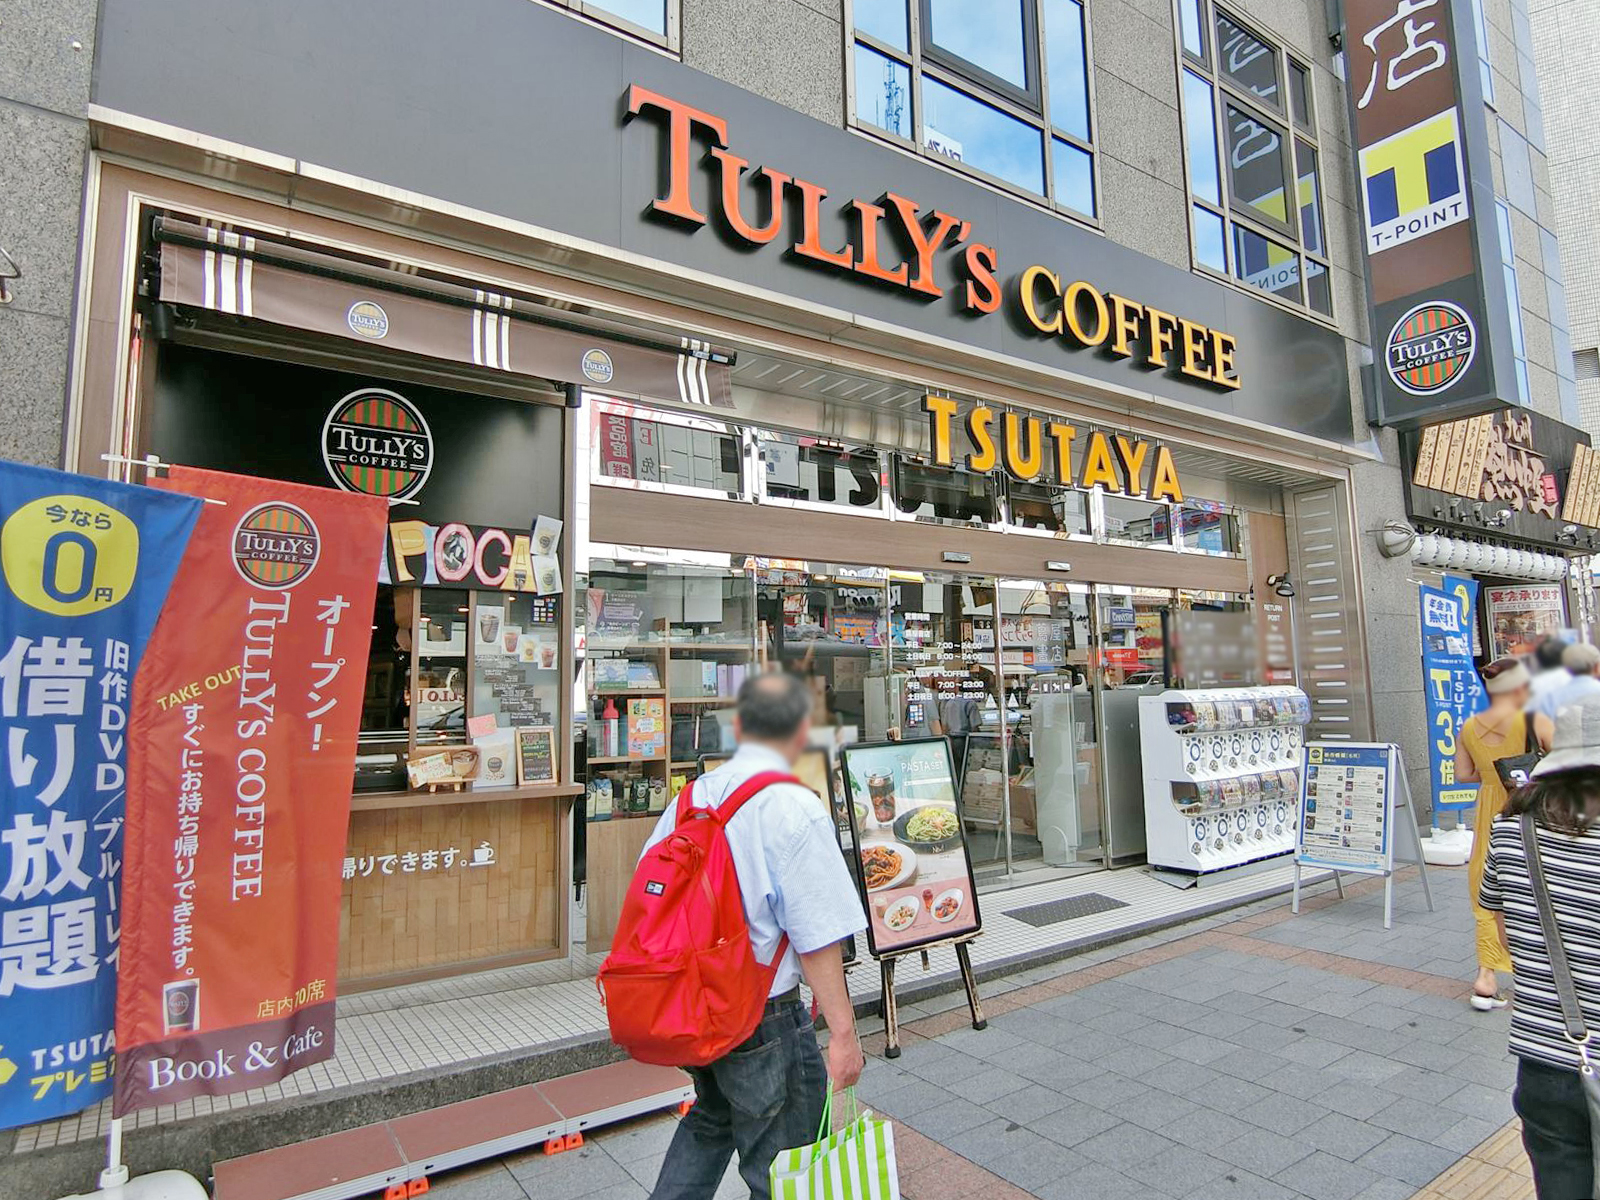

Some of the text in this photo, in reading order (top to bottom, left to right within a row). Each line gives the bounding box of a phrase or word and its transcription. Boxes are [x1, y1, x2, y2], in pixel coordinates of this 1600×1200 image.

[628, 83, 1242, 390] TULLY'S COFFEE
[1372, 202, 1463, 247] T-POINT
[1392, 331, 1467, 362] TULLY'S
[1406, 350, 1455, 369] COFFEE
[332, 427, 425, 460] TULLY'S
[348, 453, 408, 469] COFFEE
[925, 394, 1185, 503] TSUTAYA
[45, 504, 113, 530] 今なら
[240, 531, 313, 556] TULLY'S
[251, 551, 299, 563] COFFEE
[377, 521, 537, 592] PIOCA
[1263, 603, 1283, 612] RETURN
[936, 641, 953, 649] 7:00
[961, 641, 982, 650] 24:00
[157, 665, 242, 712] TAKE OUT
[305, 594, 351, 751] オープン!
[937, 681, 955, 689] 7:00
[1454, 670, 1465, 732] TSUTA
[231, 592, 291, 902] TULLY'S COFFEE
[901, 761, 930, 773] PASTA
[0, 636, 99, 996] 借り放題
[172, 702, 205, 977] すぐにお持ち帰りできます。
[256, 978, 326, 1019] 店内10席
[149, 1025, 324, 1092] Book & Cafe
